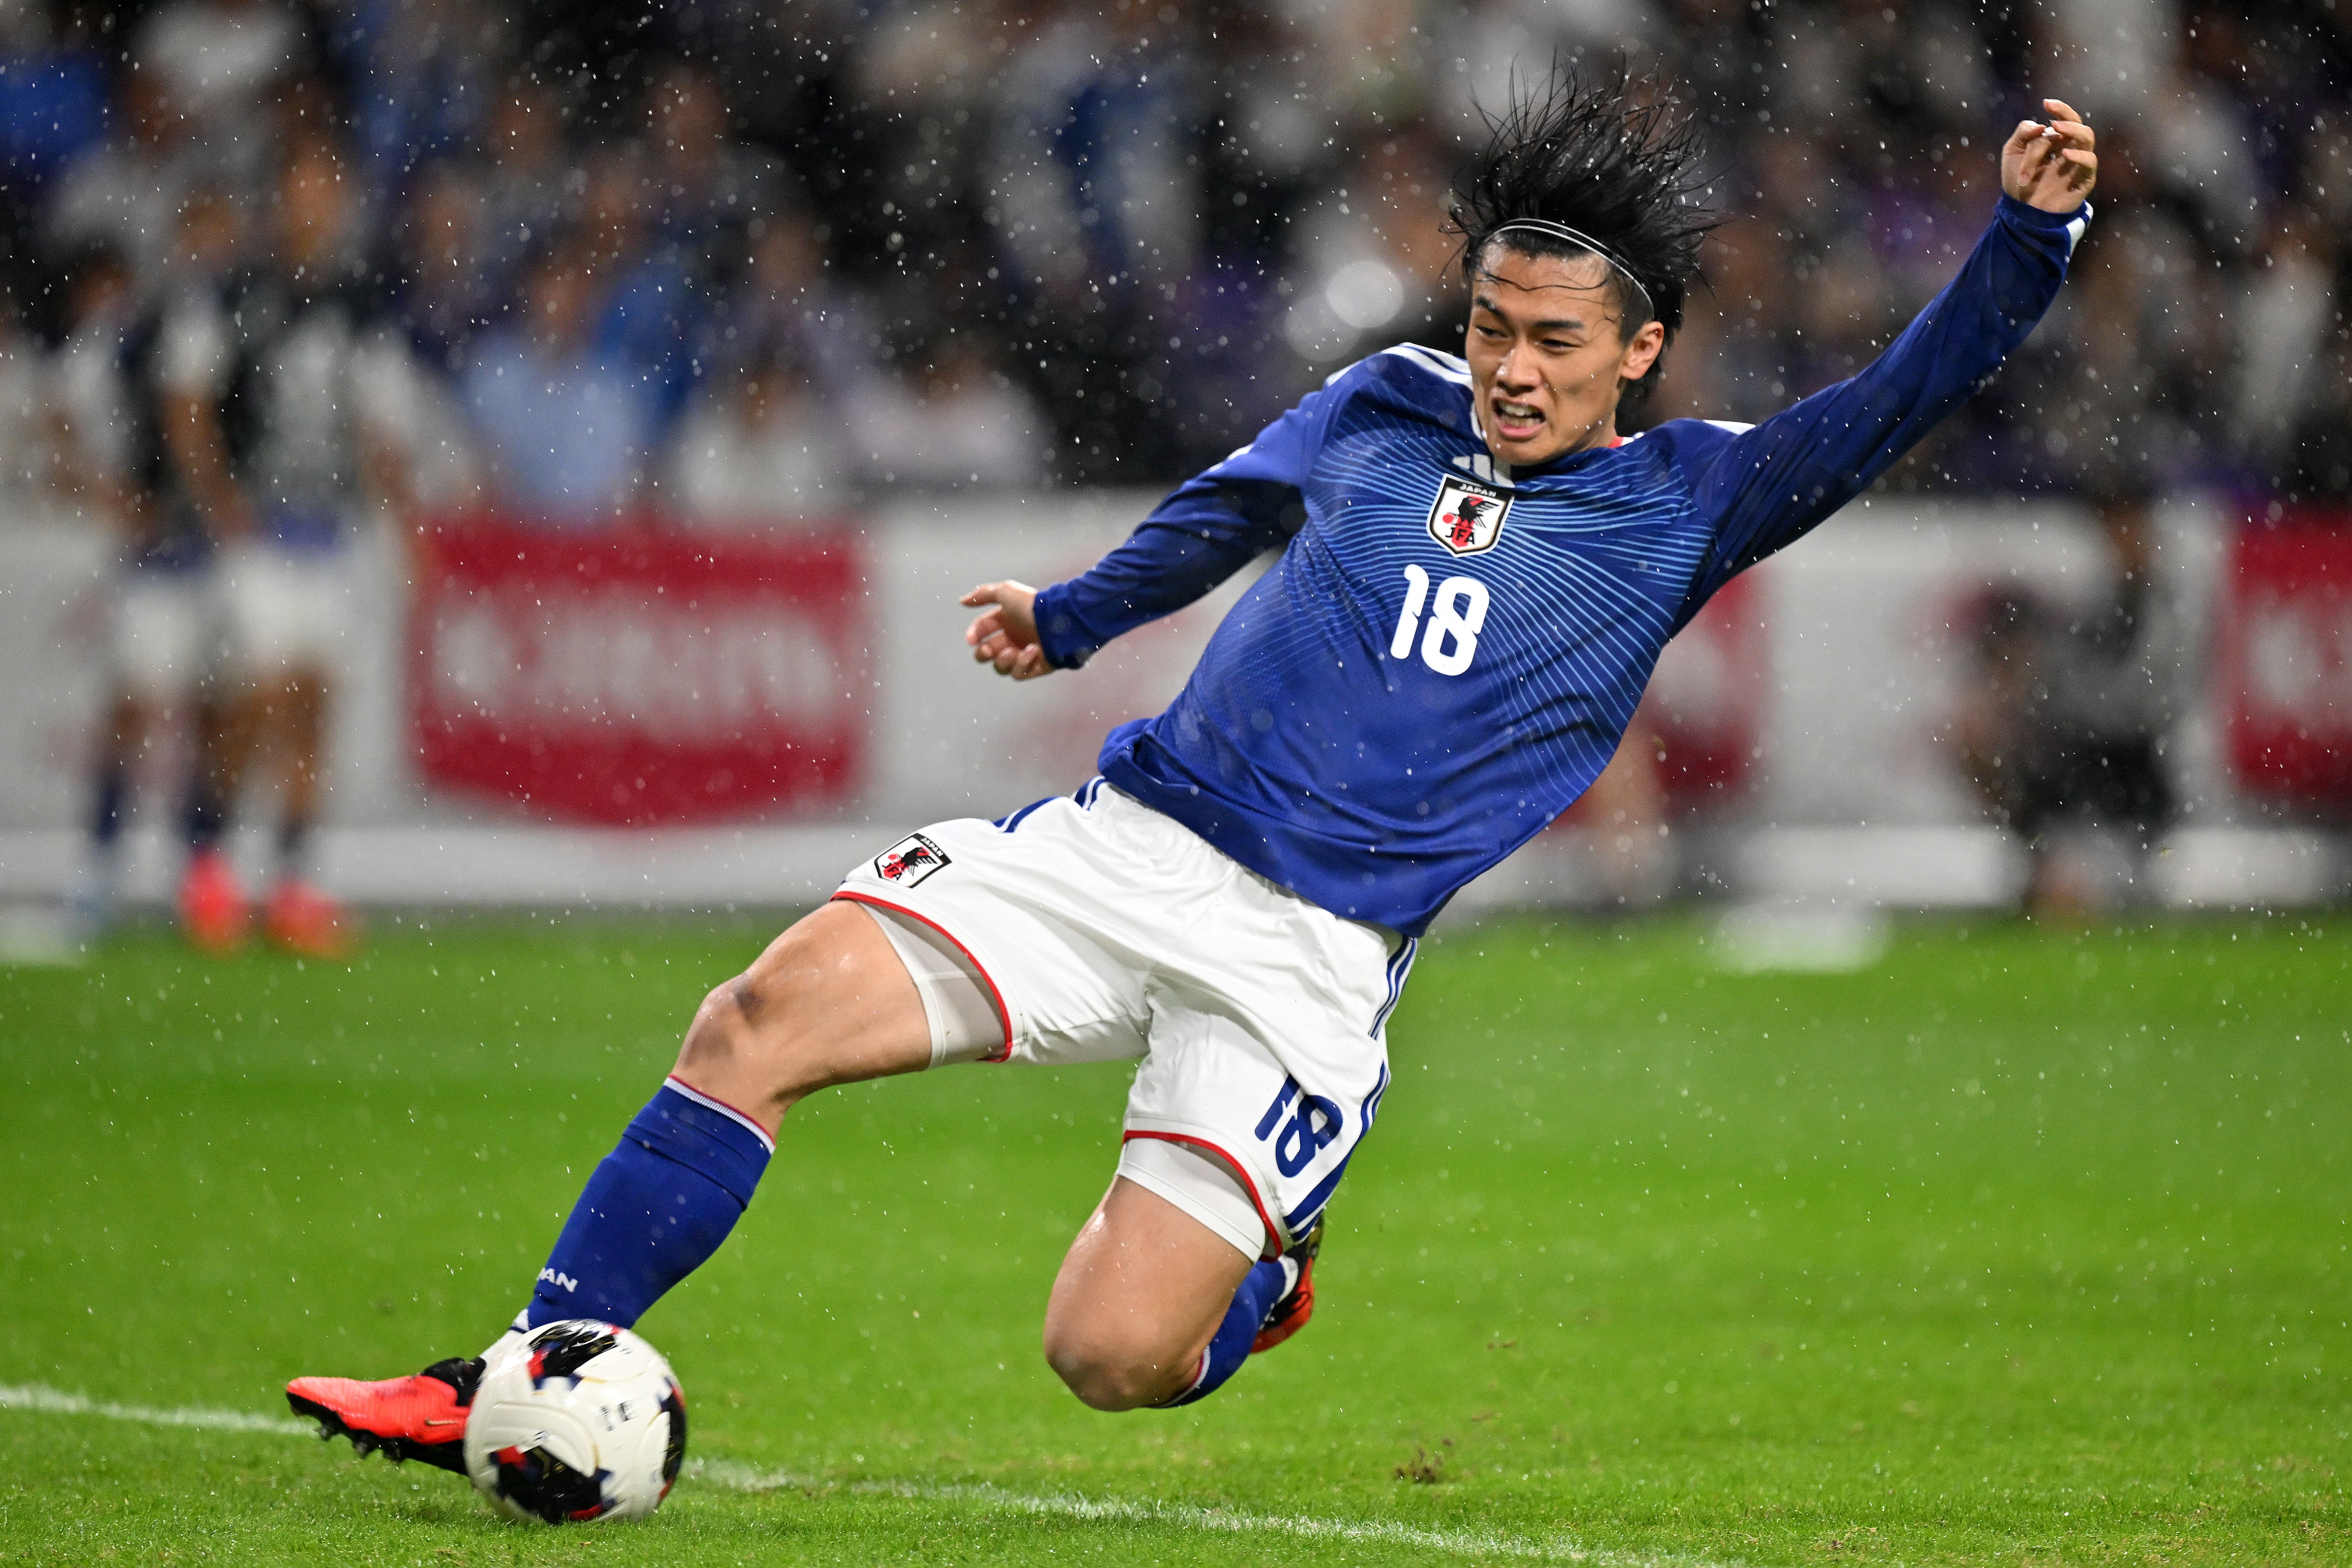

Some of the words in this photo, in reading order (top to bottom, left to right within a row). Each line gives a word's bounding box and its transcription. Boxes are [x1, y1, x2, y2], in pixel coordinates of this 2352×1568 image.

[1459, 483, 1496, 497] JAPAN
[1445, 527, 1475, 545] JFA
[1391, 564, 1489, 676] 18
[920, 837, 944, 857] JAPAN
[882, 863, 902, 881] JFA
[1255, 1073, 1343, 1178] 18
